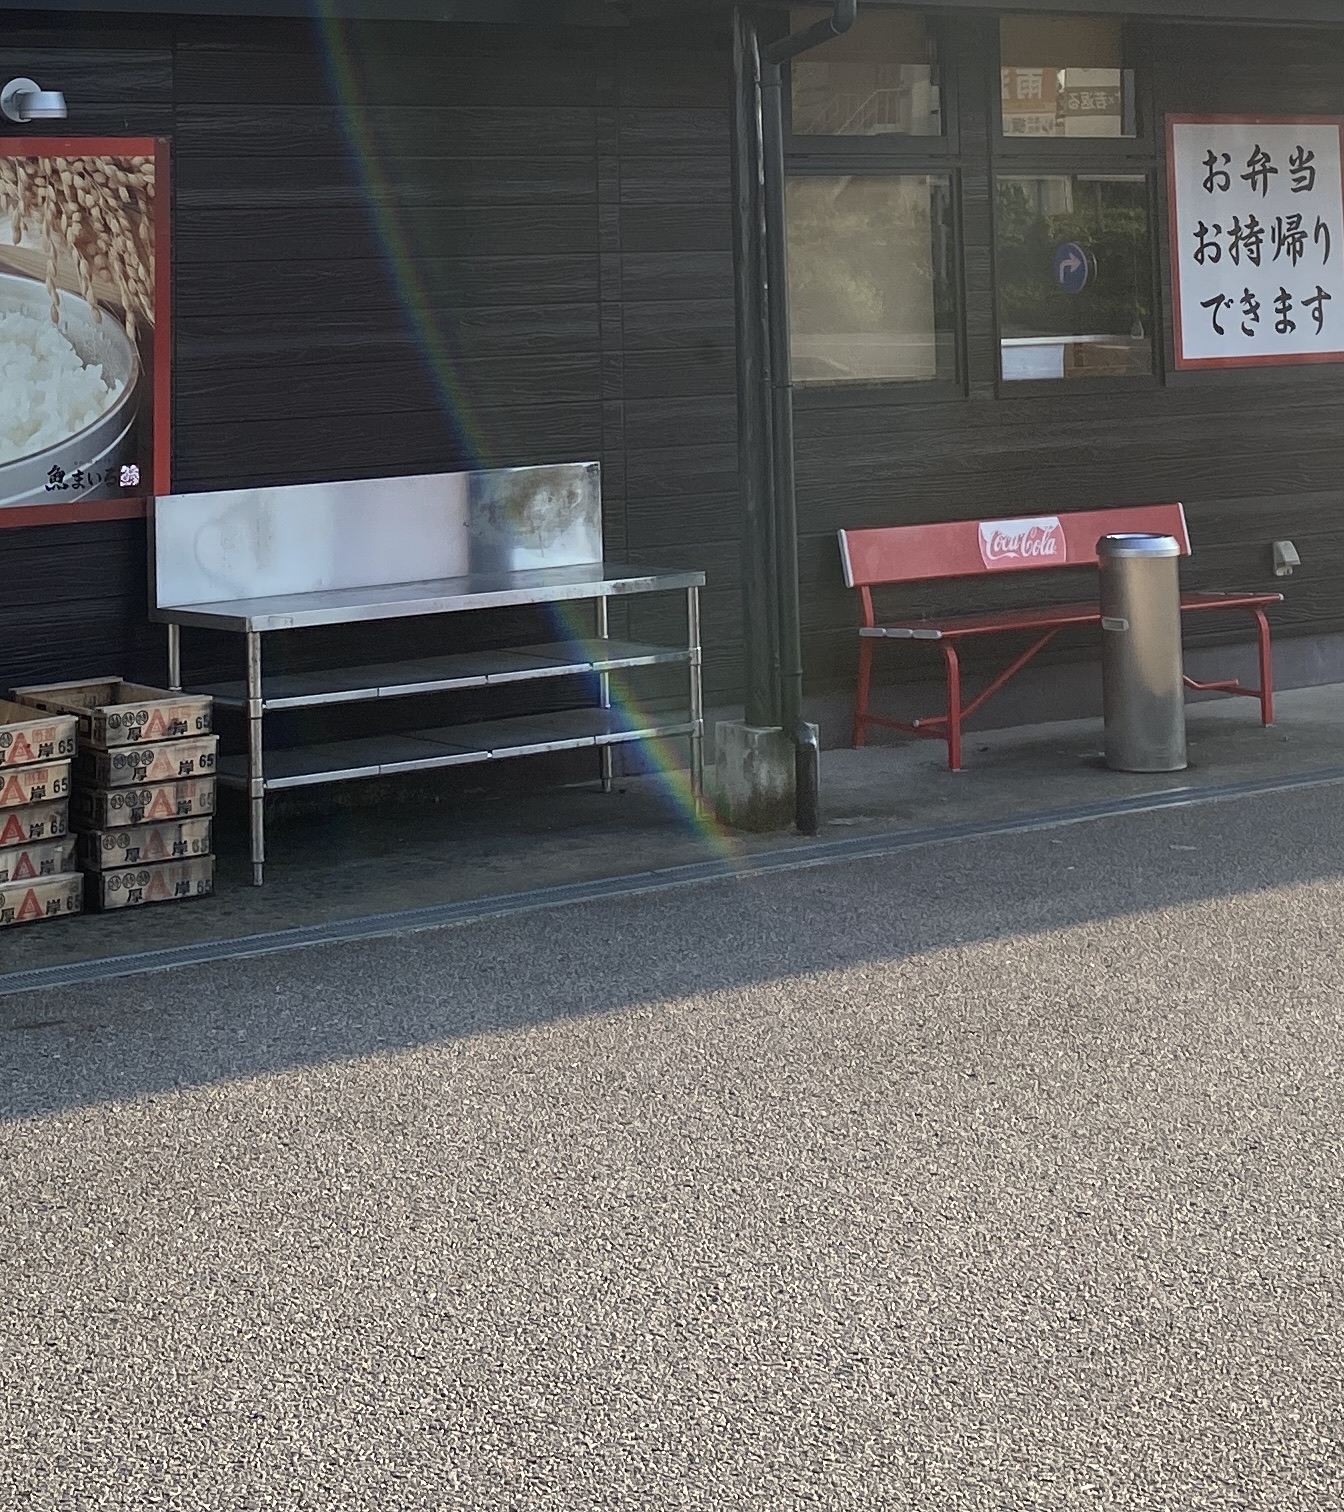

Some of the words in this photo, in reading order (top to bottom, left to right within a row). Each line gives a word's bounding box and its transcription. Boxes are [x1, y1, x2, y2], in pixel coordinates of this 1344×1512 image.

[1202, 144, 1316, 198] お弁当
[1193, 213, 1331, 267] お持帰り
[1199, 286, 1332, 337] できます
[45, 465, 117, 491] 魚まいる
